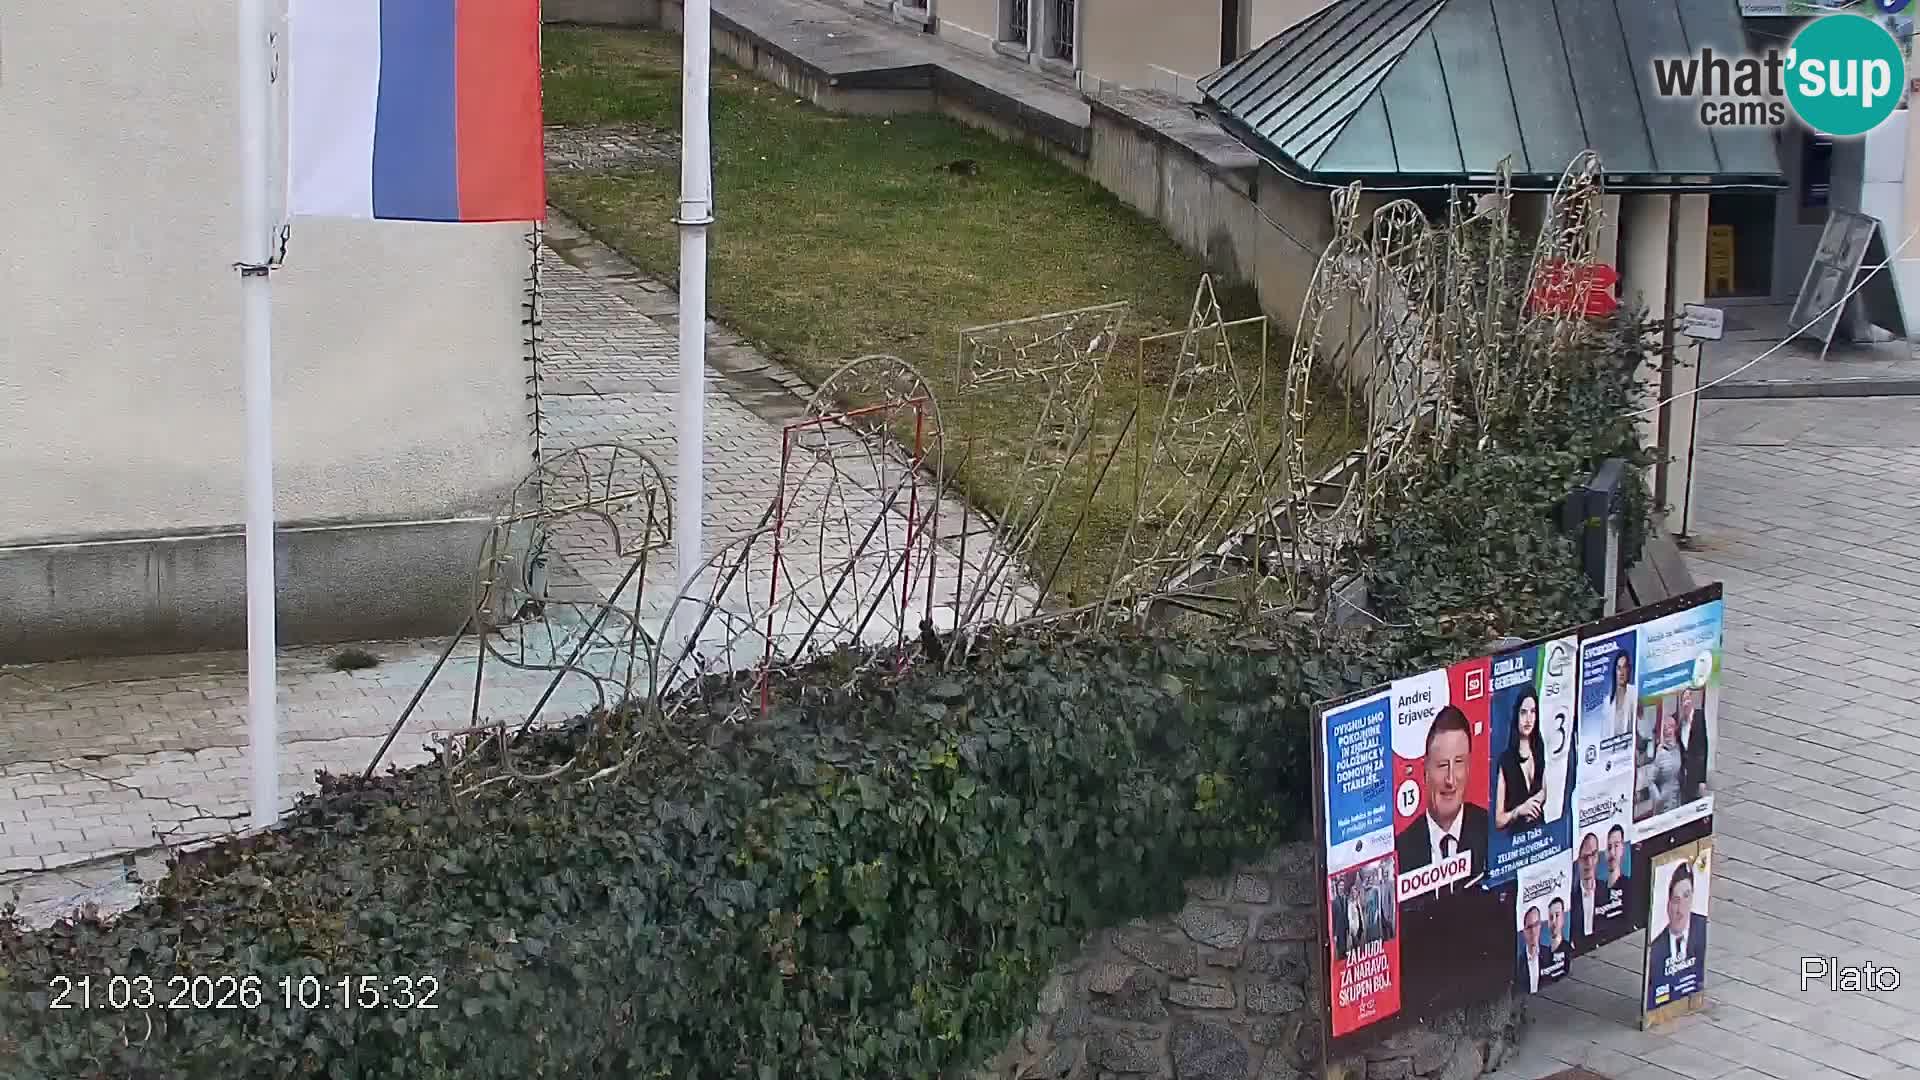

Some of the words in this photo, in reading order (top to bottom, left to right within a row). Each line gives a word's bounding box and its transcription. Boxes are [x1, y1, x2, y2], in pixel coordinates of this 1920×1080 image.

[1398, 686, 1432, 708] Andrej
[1368, 711, 1385, 727] SMO
[1398, 706, 1435, 726] Erjavec
[1553, 712, 1566, 755] 3
[1341, 746, 1350, 759] IN
[1378, 747, 1385, 759] V
[1374, 759, 1385, 772] ZA
[1402, 789, 1415, 808] 13
[1401, 858, 1467, 895] DOGOVOR
[1346, 951, 1358, 967] ZA
[1341, 970, 1353, 988] ZA
[1339, 979, 1373, 1007] SKUPEN
